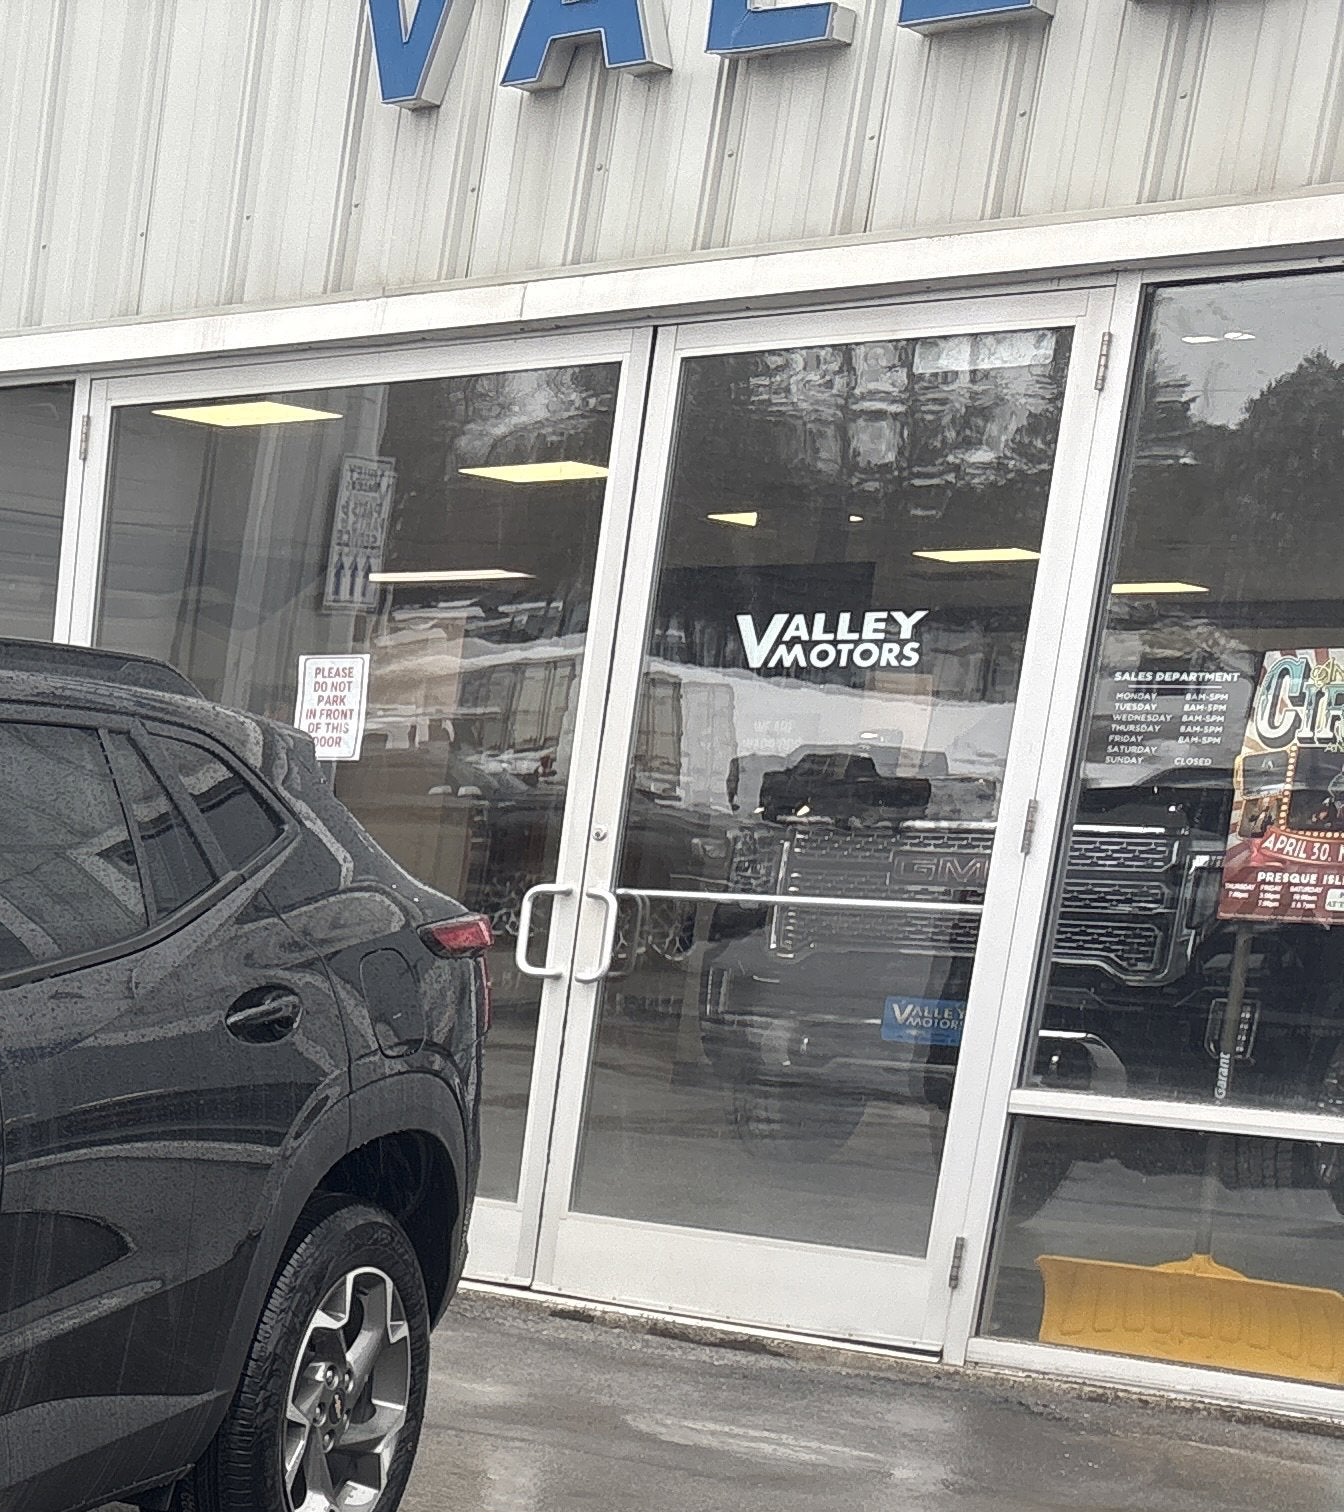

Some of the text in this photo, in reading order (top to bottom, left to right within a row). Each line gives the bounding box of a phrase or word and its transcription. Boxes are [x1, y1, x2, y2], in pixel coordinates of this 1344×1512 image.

[737, 610, 929, 669] VALLEY
[767, 642, 921, 668] MOTORS
[314, 667, 354, 679] PLEASE
[1114, 671, 1240, 683] SALES DEPARTMENT
[313, 681, 353, 693] DO NOT
[317, 695, 347, 706] PARK
[1116, 692, 1158, 700] MONDAY
[1115, 702, 1158, 711] TUESDAY
[306, 708, 354, 720] IN FRONT
[1112, 714, 1173, 722] WEDNESDAY
[308, 722, 349, 734] OF THIS
[1111, 723, 1162, 732] THURSDAY
[1108, 734, 1144, 743] FRIDAY
[1106, 745, 1158, 754] SATURDAY
[1105, 756, 1213, 766] SUNDAY CLOSED
[1261, 832, 1308, 859] APRIL
[894, 854, 990, 883] GM
[1257, 871, 1344, 886] PRESQUE ISL
[1214, 1051, 1231, 1099] Garant
